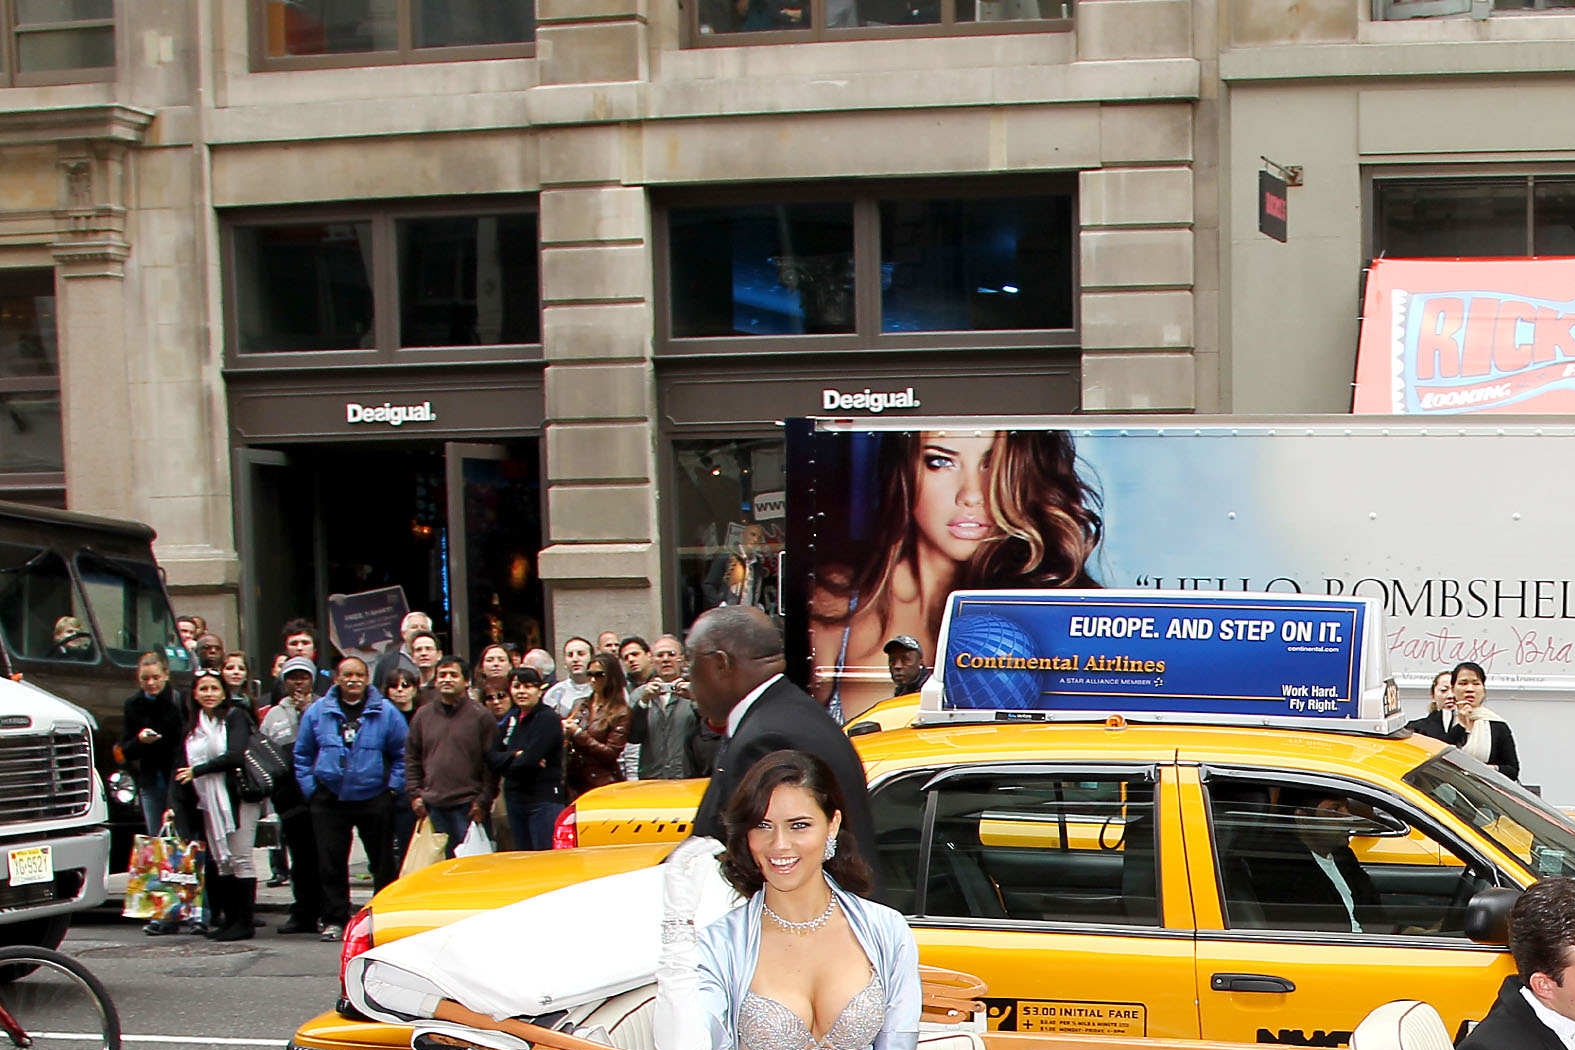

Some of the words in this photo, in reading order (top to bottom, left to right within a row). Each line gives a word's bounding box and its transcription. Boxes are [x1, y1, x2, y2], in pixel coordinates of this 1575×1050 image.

[1419, 382, 1512, 410] LOOKING
[1069, 616, 1159, 638] EUROPE.
[1165, 618, 1214, 640] AND
[1219, 619, 1275, 641] STEP
[1281, 620, 1313, 642] ON
[1319, 621, 1343, 643] IT.
[1387, 626, 1509, 674] Fantasy
[1511, 625, 1574, 665] Bra
[956, 652, 1079, 671] Continental
[1083, 654, 1166, 673] Airlines
[1282, 685, 1308, 697] Work
[1311, 685, 1339, 698] Hard.
[1290, 698, 1306, 712] Fly
[1308, 698, 1338, 713] Right.
[1023, 1006, 1057, 1016] $3.00
[1059, 1008, 1103, 1018] INITIAL
[1108, 1010, 1139, 1019] FARE
